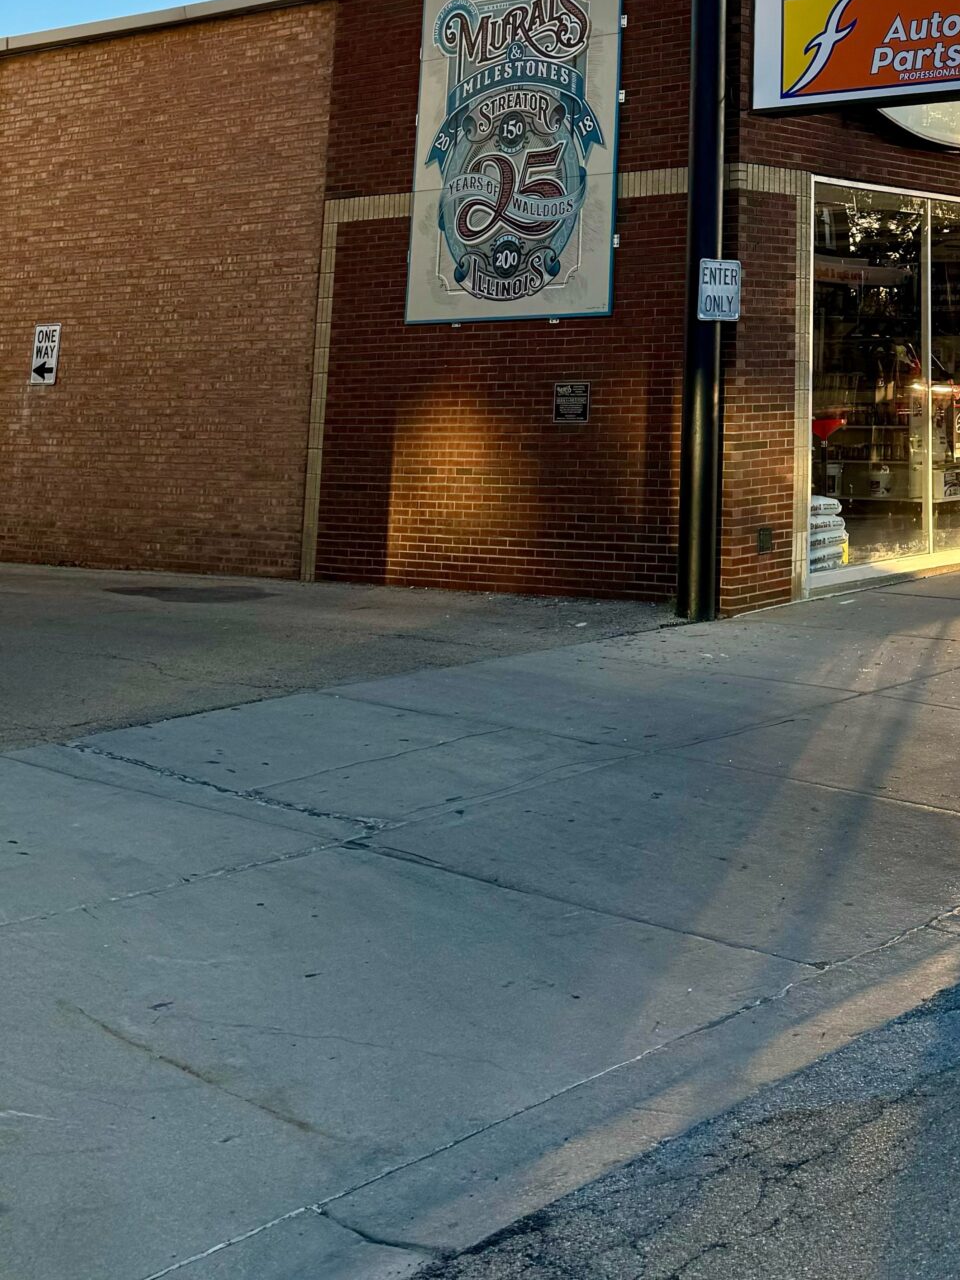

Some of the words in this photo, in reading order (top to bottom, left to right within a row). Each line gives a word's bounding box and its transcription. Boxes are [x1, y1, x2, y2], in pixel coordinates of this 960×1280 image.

[510, 45, 524, 60] &
[462, 60, 570, 99] MILESTONES
[478, 91, 559, 132] STREATOR
[435, 133, 450, 151] 20
[578, 115, 594, 136] 18
[502, 120, 523, 139] 150
[449, 177, 483, 196] YEARS
[486, 180, 500, 197] OF
[512, 197, 574, 217] WALLDOGS
[454, 140, 568, 245] 25
[496, 250, 517, 269] 200
[470, 254, 545, 297] ILLINOIS
[702, 266, 738, 286] ENTER
[705, 294, 734, 313] ONLY
[37, 329, 57, 344] ONE
[36, 345, 56, 359] WAY
